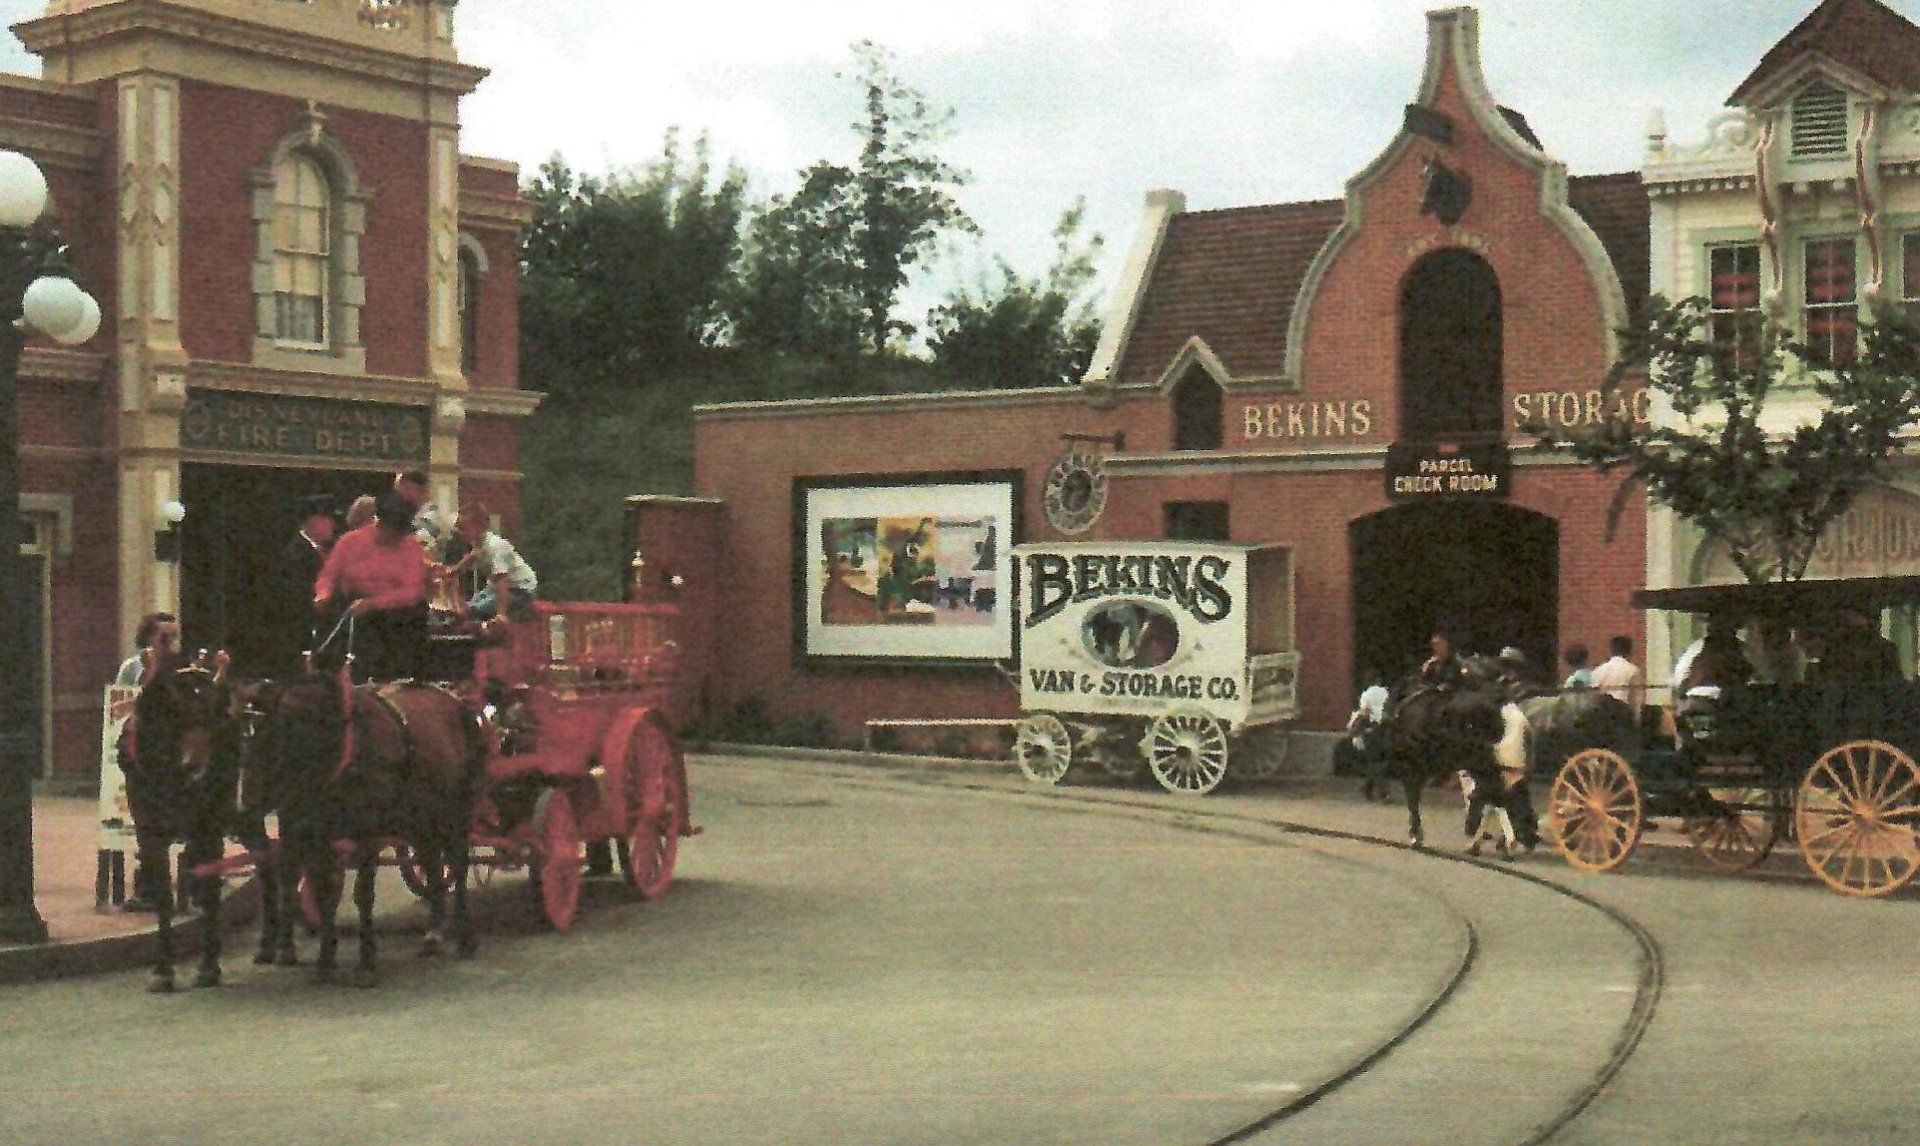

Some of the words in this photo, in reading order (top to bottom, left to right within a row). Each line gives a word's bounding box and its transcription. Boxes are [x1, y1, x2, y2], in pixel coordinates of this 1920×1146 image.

[1243, 400, 1371, 438] BEKINS
[1511, 387, 1650, 428] STORAG
[217, 424, 291, 447] FIRE
[1449, 474, 1498, 492] ROOM
[1025, 553, 1232, 628] BEKINS
[1029, 668, 1075, 693] VAN
[1080, 674, 1096, 693] &
[1100, 672, 1203, 699] STORAGE
[1207, 676, 1240, 701] CO.
